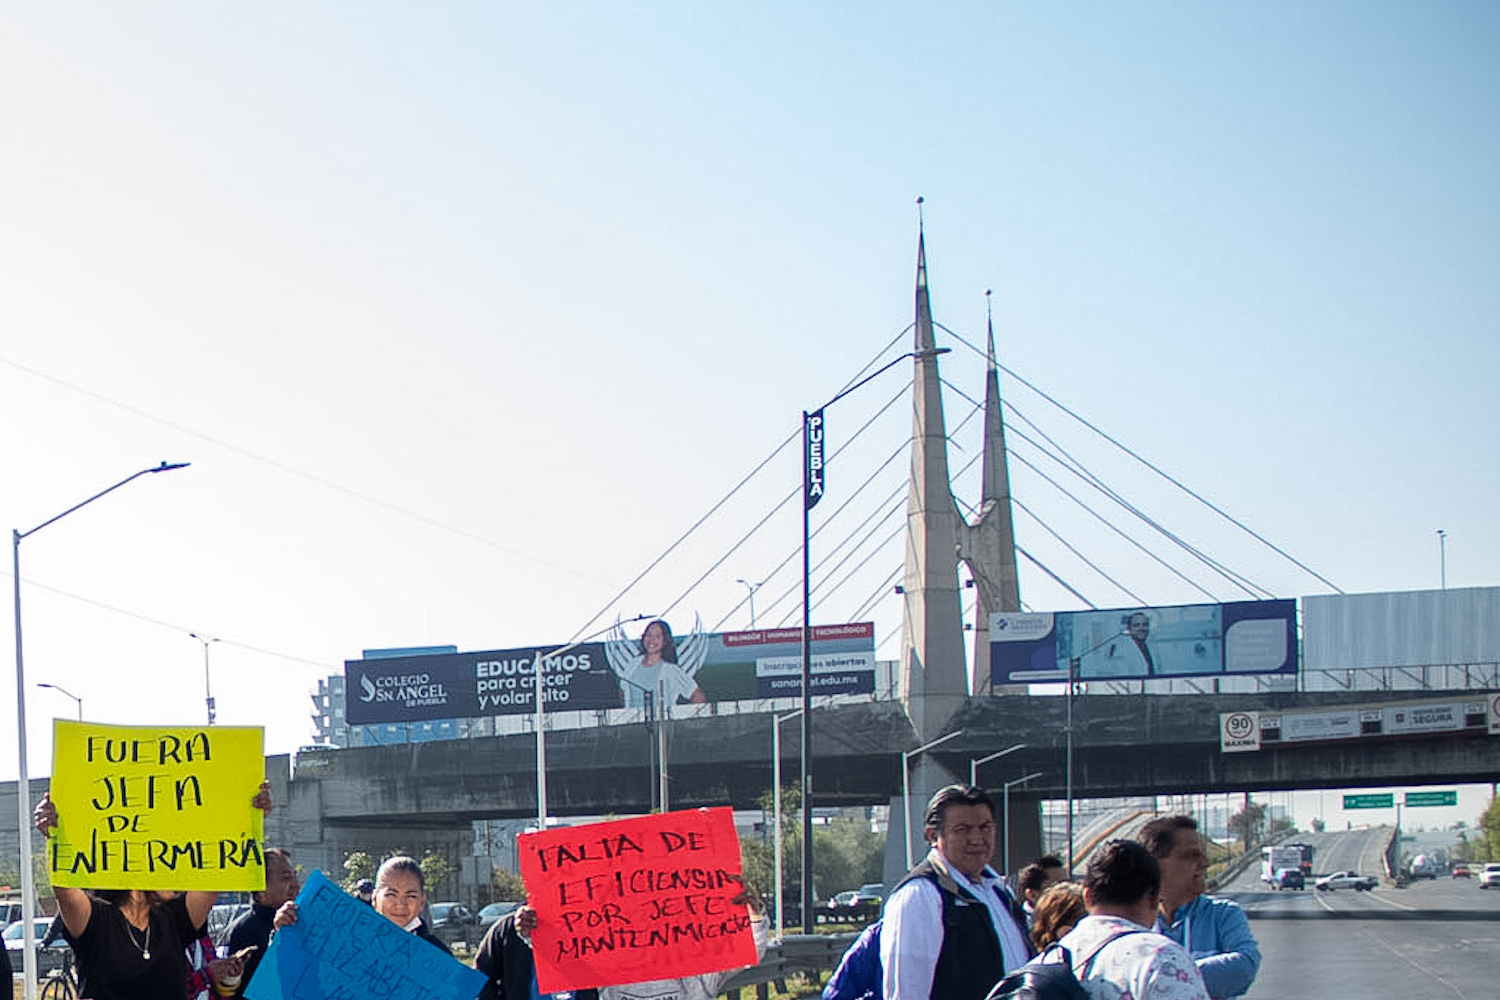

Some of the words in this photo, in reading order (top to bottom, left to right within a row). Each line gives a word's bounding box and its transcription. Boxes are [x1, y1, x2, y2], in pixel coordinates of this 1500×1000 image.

[810, 417, 822, 496] PUEBLA
[476, 654, 591, 678] EDUCAMOS
[376, 674, 430, 687] COLEGIO
[477, 679, 517, 694] para
[417, 697, 447, 706] PUEBLA
[478, 696, 488, 710] y
[490, 690, 533, 705] volar
[1231, 718, 1249, 729] 90
[86, 732, 212, 765] FUERA
[92, 773, 202, 811] JEFA
[101, 814, 150, 833] DE
[531, 833, 644, 872] FALTA
[660, 832, 704, 852] DE
[559, 869, 742, 906] EFICIENSIA
[309, 884, 412, 967] FUERA
[561, 904, 631, 932] POR
[644, 893, 726, 920] JEFE
